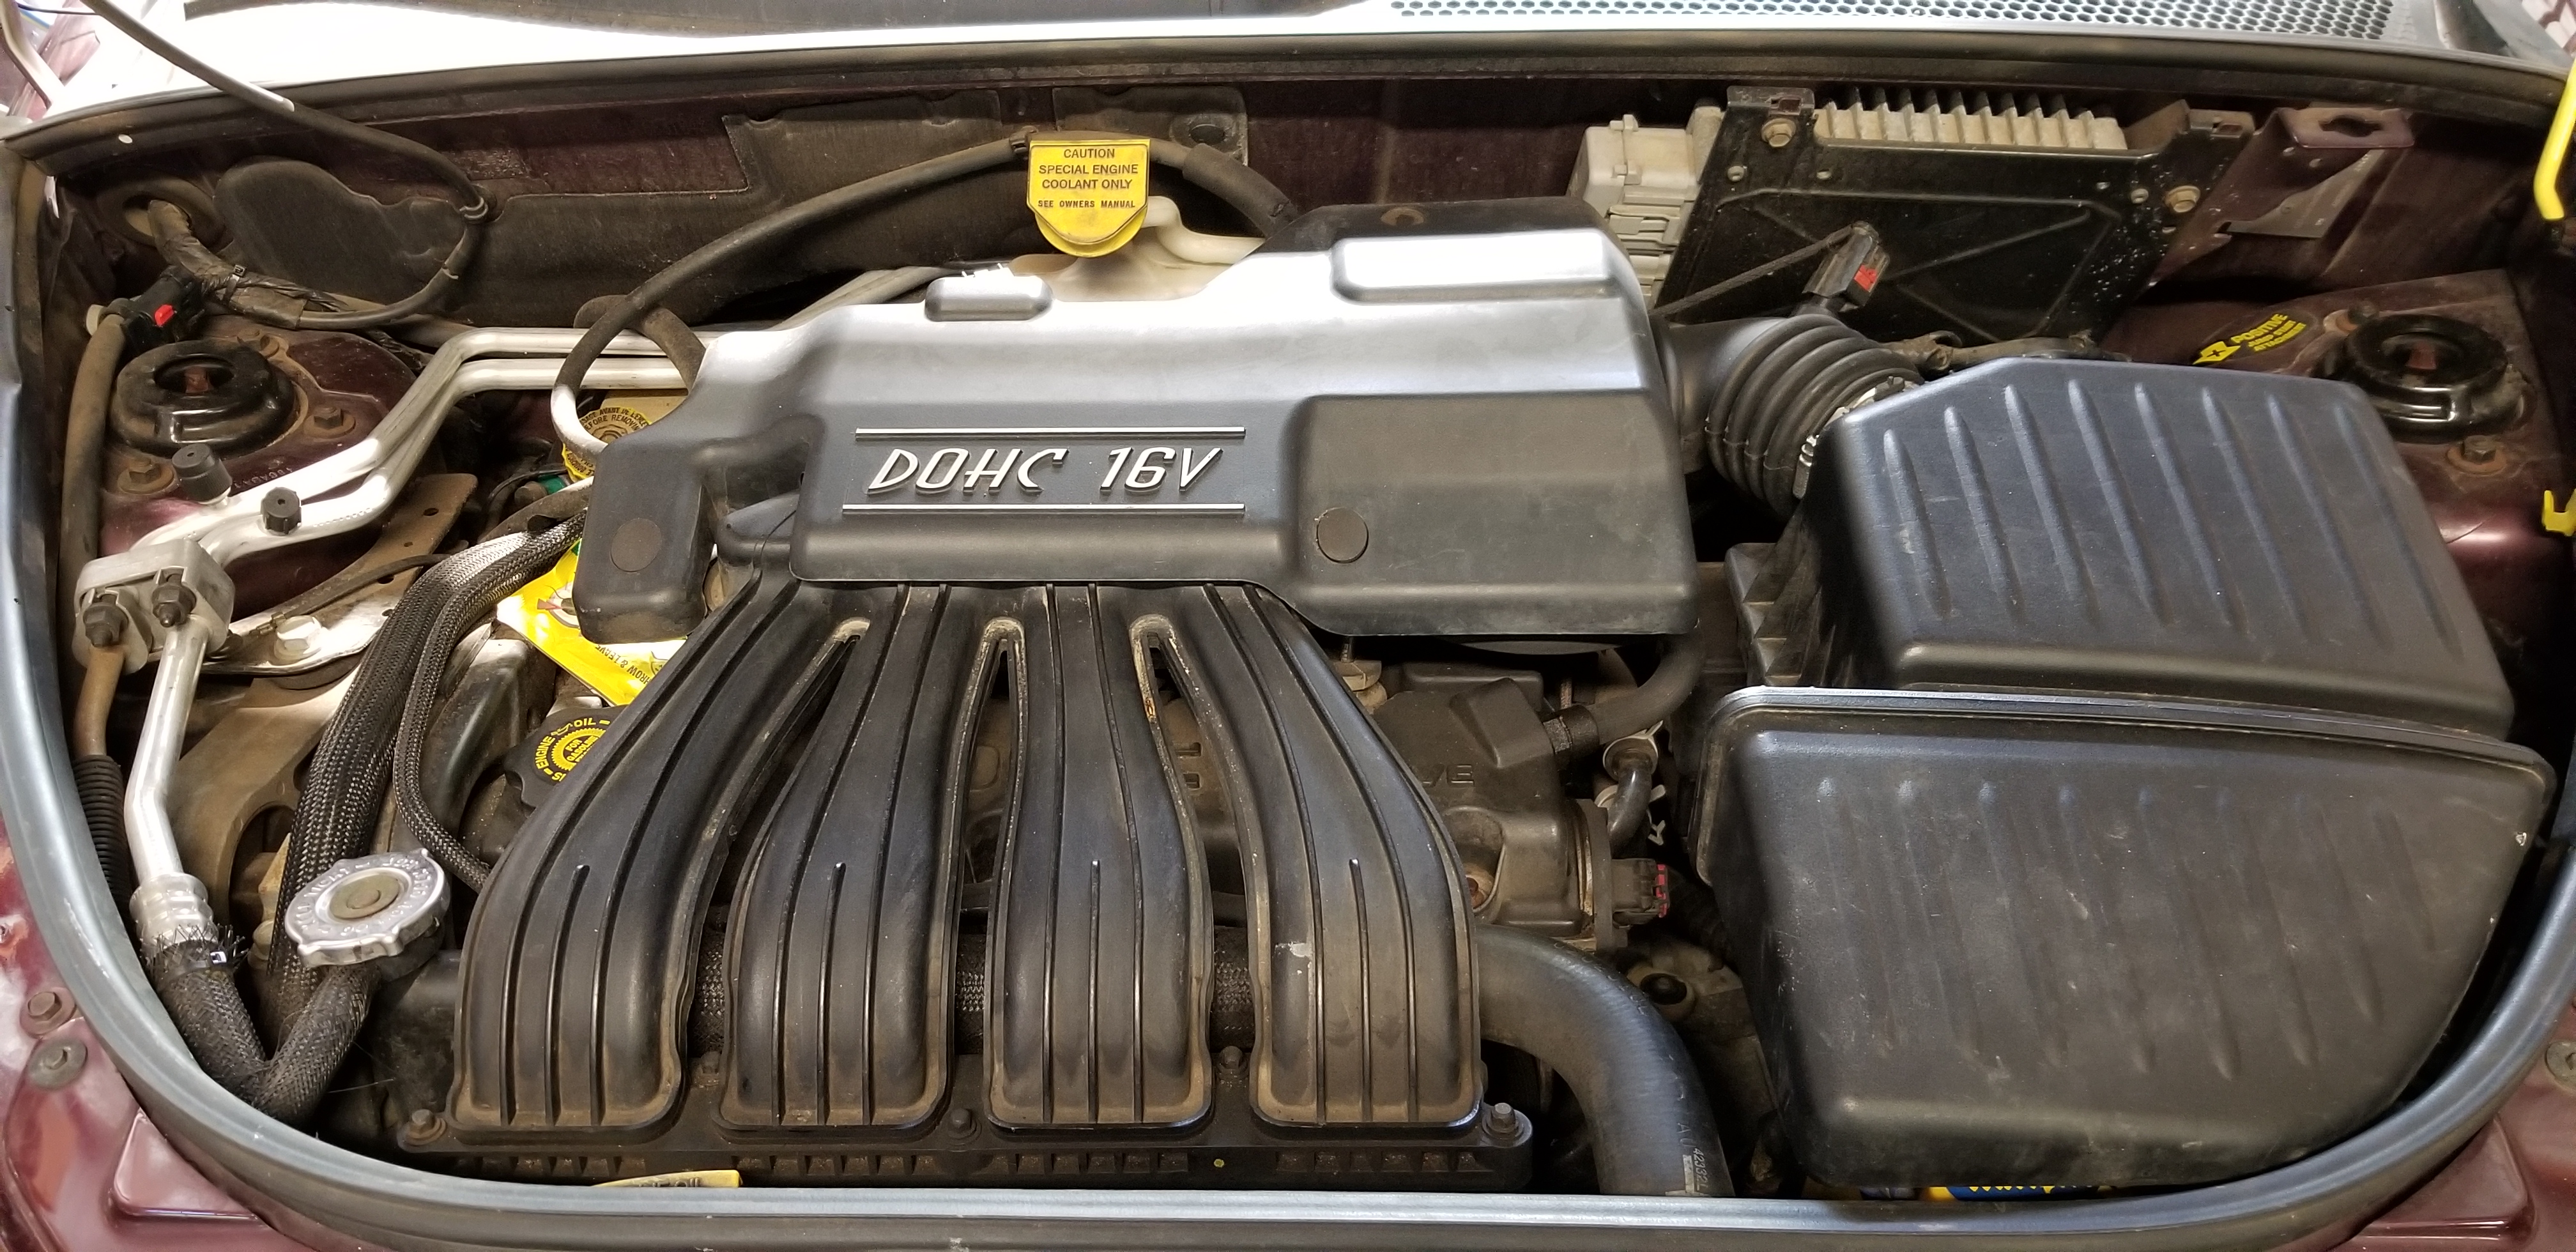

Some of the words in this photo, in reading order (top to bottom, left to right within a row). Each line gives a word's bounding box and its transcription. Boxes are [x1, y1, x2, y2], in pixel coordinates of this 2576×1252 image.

[1063, 148, 1116, 159] CAUTION
[1038, 165, 1090, 174] SPECIAL
[1092, 164, 1139, 174] ENGINE
[1041, 179, 1099, 189] COOLANT
[1101, 179, 1133, 189] ONLY
[1100, 200, 1136, 208] MANUAL
[584, 415, 608, 430] EFORE
[866, 448, 1070, 494] DOHC
[1099, 447, 1224, 493] 16V
[626, 664, 652, 685] HROW
[535, 735, 556, 770] ENGINE
[574, 717, 597, 728] OIL
[565, 738, 583, 752] FOR
